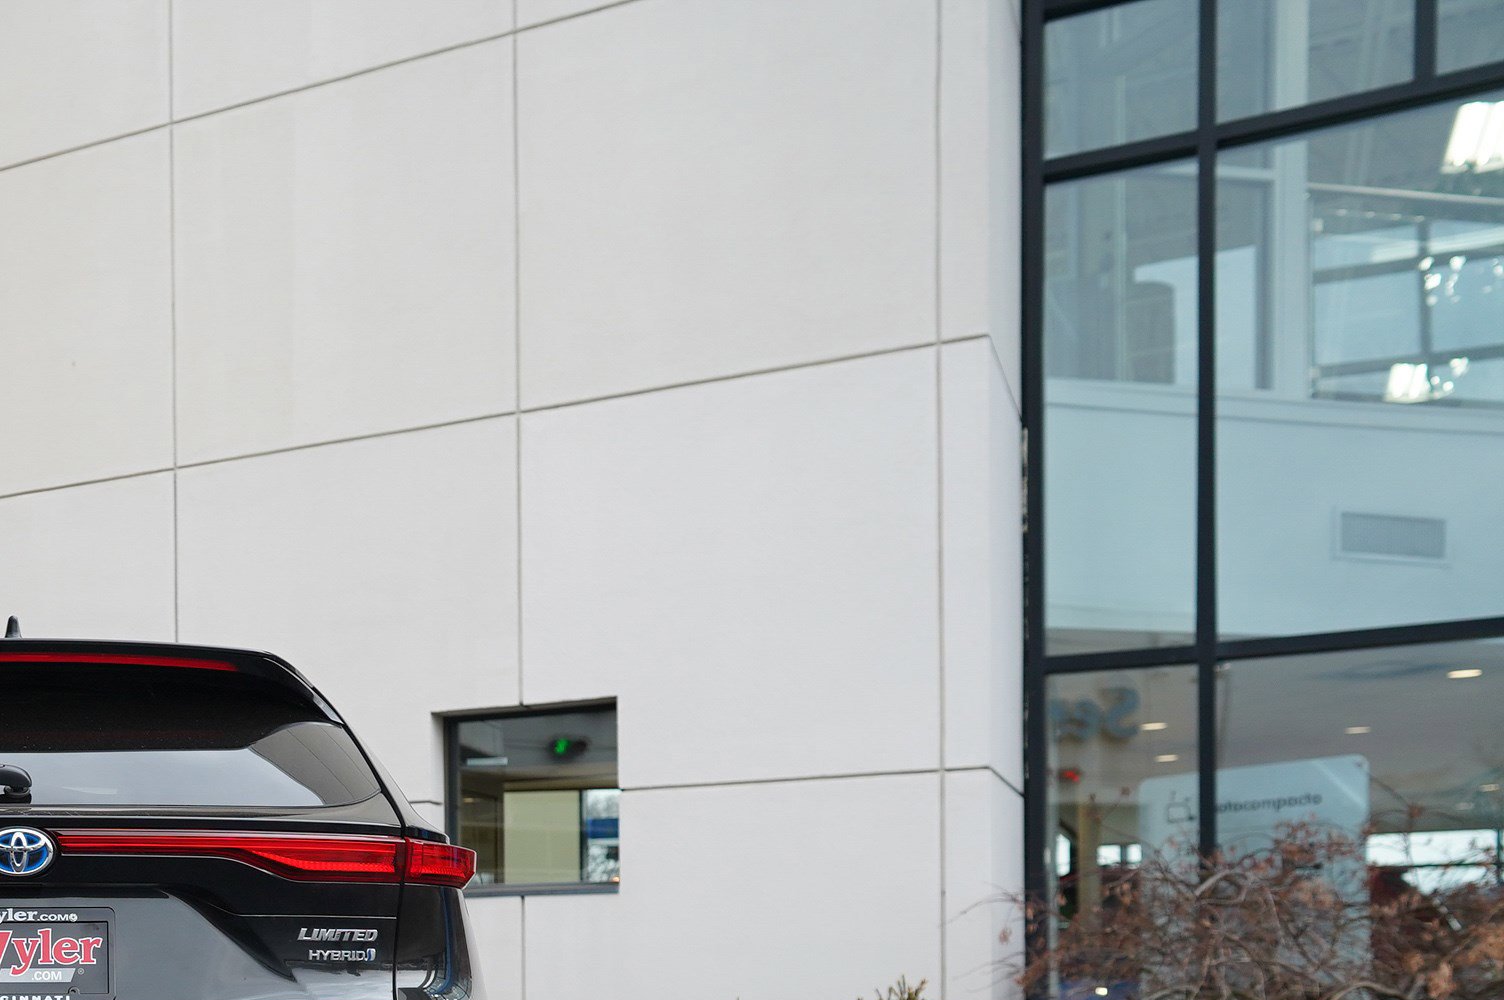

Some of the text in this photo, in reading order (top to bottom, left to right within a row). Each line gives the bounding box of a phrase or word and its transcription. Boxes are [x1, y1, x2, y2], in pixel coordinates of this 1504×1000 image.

[1216, 793, 1324, 815] otocompacto
[297, 927, 378, 942] LIMITED
[308, 949, 368, 962] HYBRID
